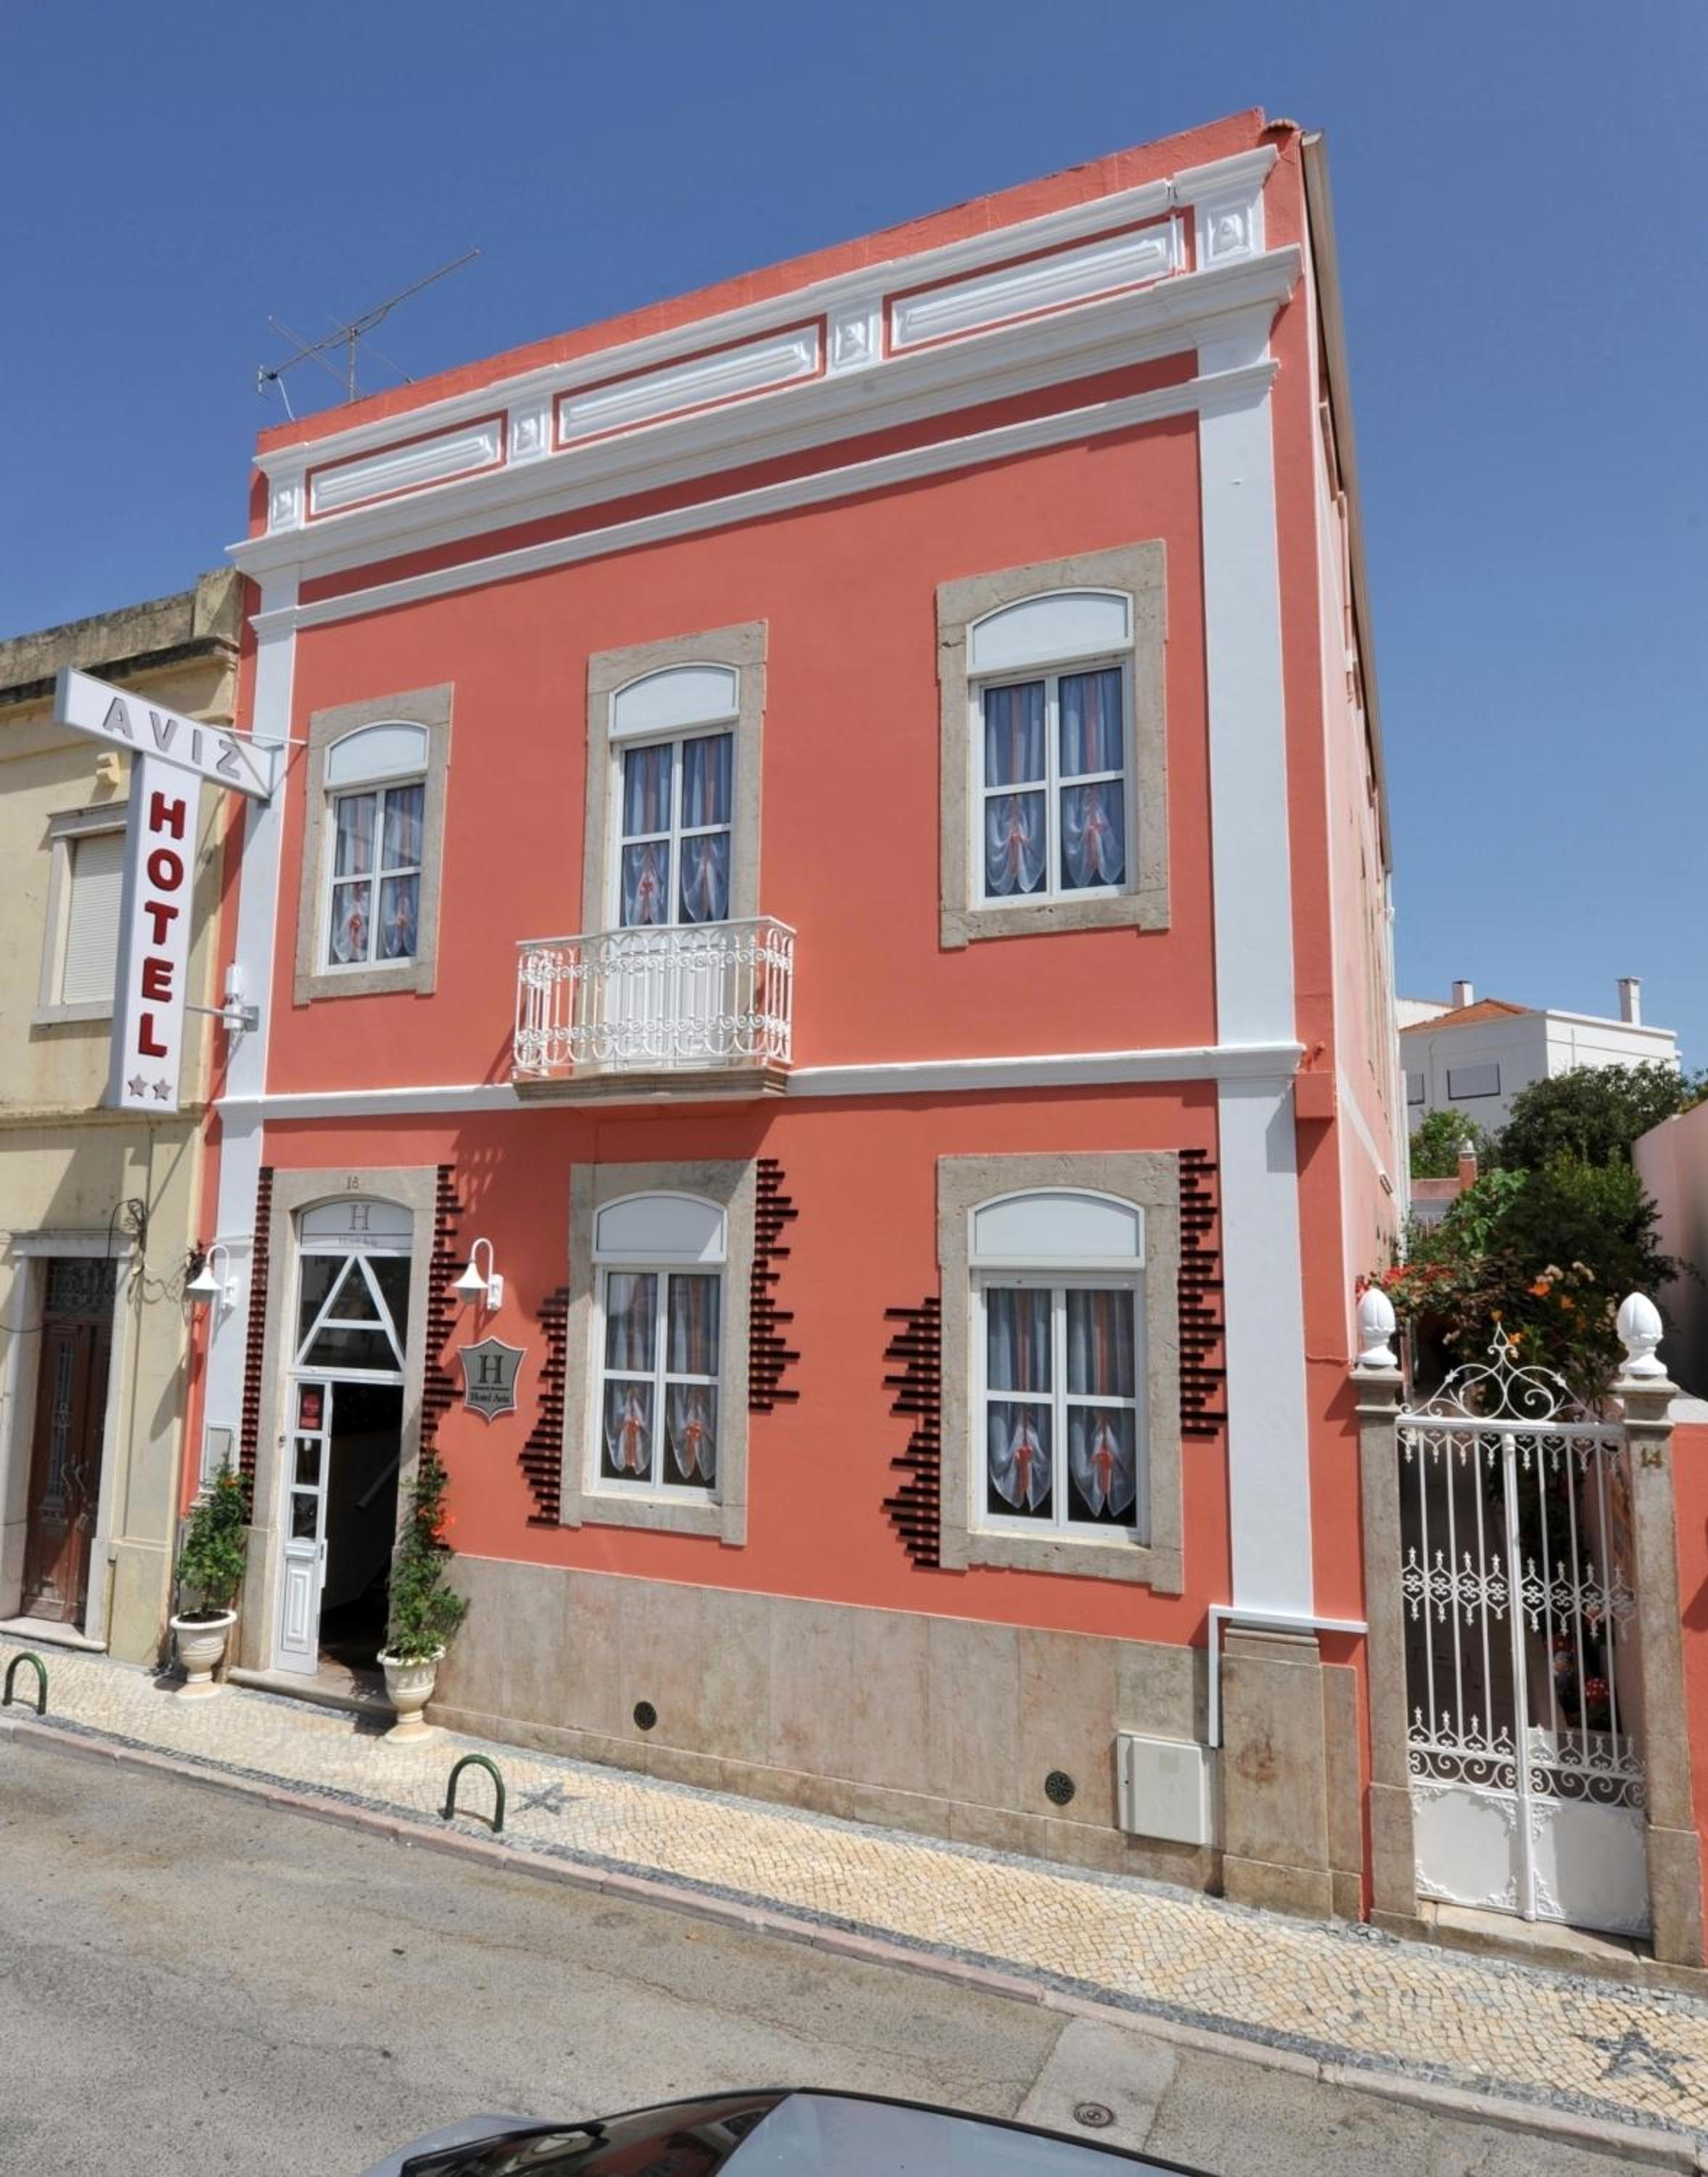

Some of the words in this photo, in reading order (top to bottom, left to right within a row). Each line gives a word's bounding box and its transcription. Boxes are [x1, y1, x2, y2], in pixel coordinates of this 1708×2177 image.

[102, 697, 242, 779] AVIZ
[138, 791, 186, 1059] HOTEL
[348, 1204, 371, 1231] H
[478, 1354, 504, 1384] H
[1641, 1448, 1663, 1468] 14
